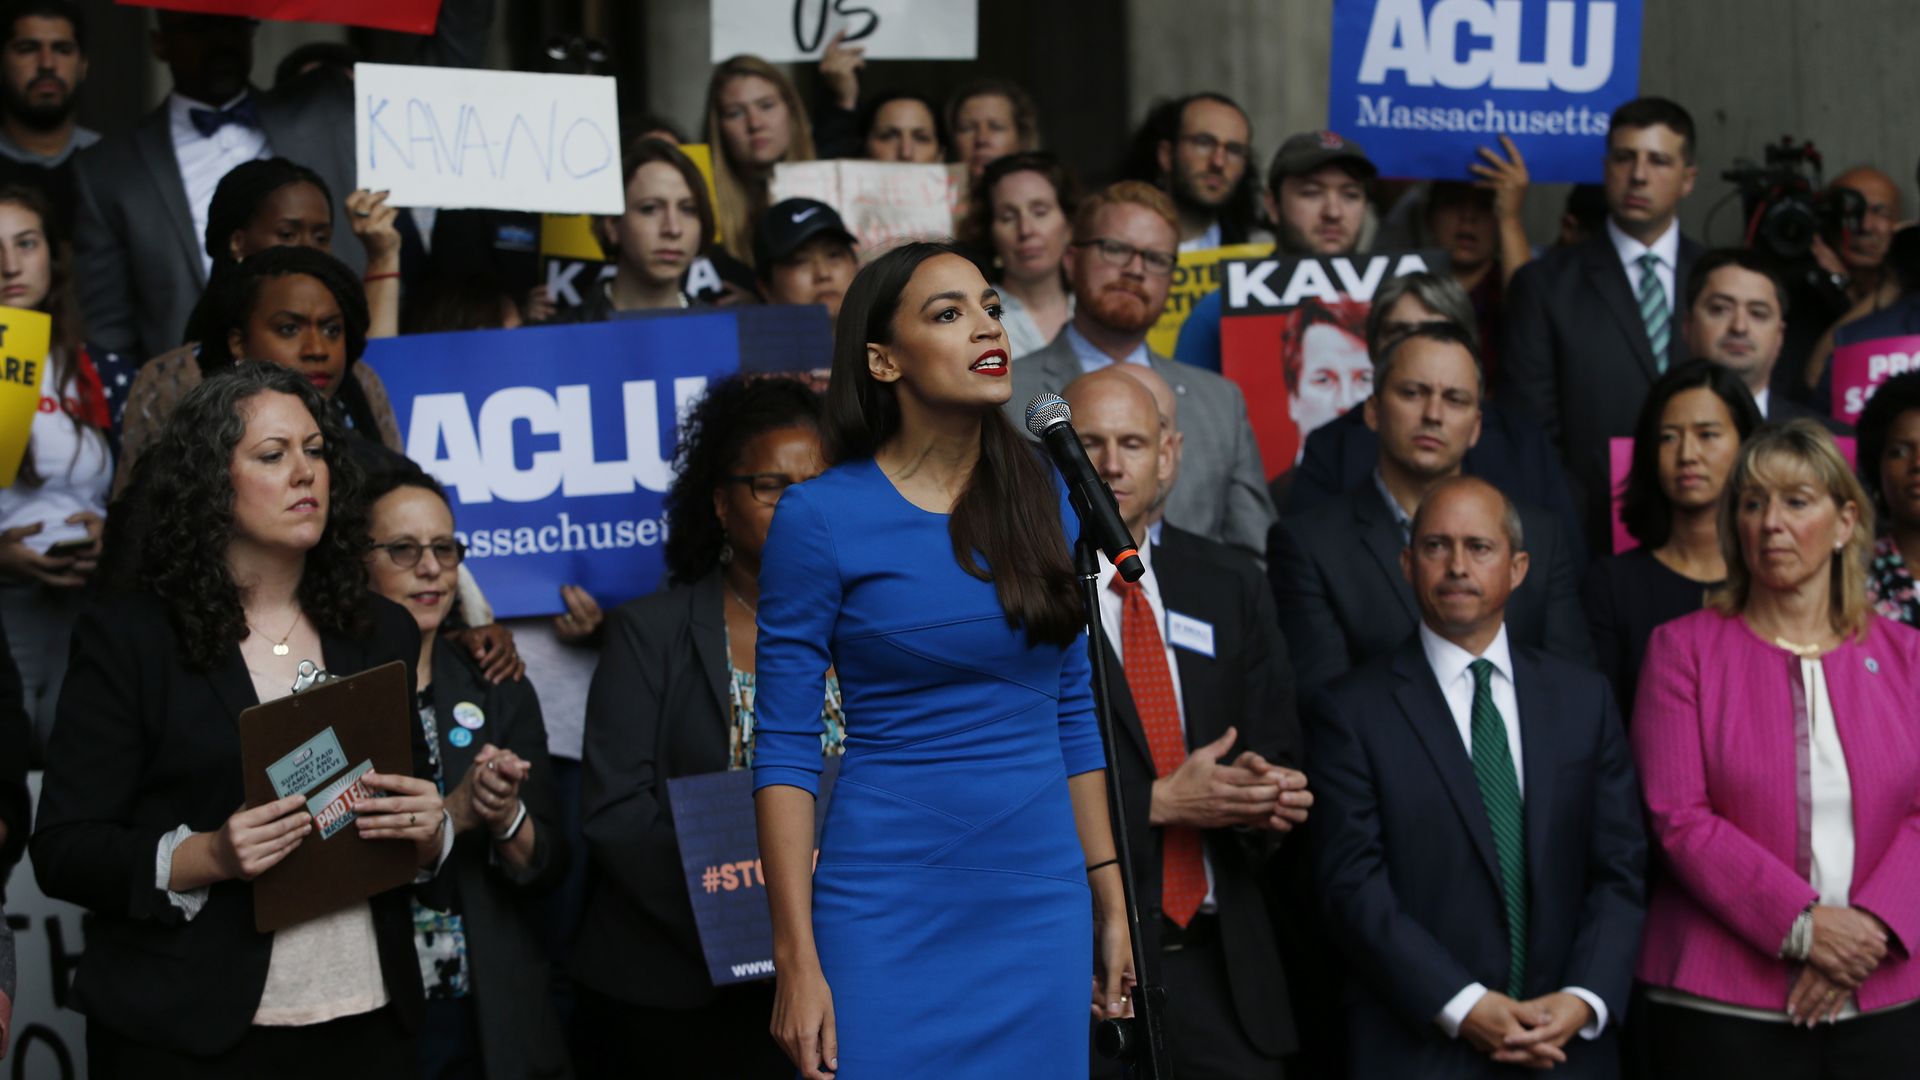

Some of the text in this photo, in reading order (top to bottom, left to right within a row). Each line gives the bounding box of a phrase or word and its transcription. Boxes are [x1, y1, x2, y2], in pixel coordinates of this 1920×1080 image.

[1356, 0, 1617, 93] ACLU
[1356, 94, 1610, 136] Massachusetts
[405, 376, 707, 504] ACLU
[281, 761, 314, 787] SUPPORT
[316, 748, 333, 762] PAID
[287, 768, 314, 789] FAMILY
[316, 757, 333, 770] AND
[318, 758, 341, 777] LEAVE
[316, 780, 370, 830] PAID LEA
